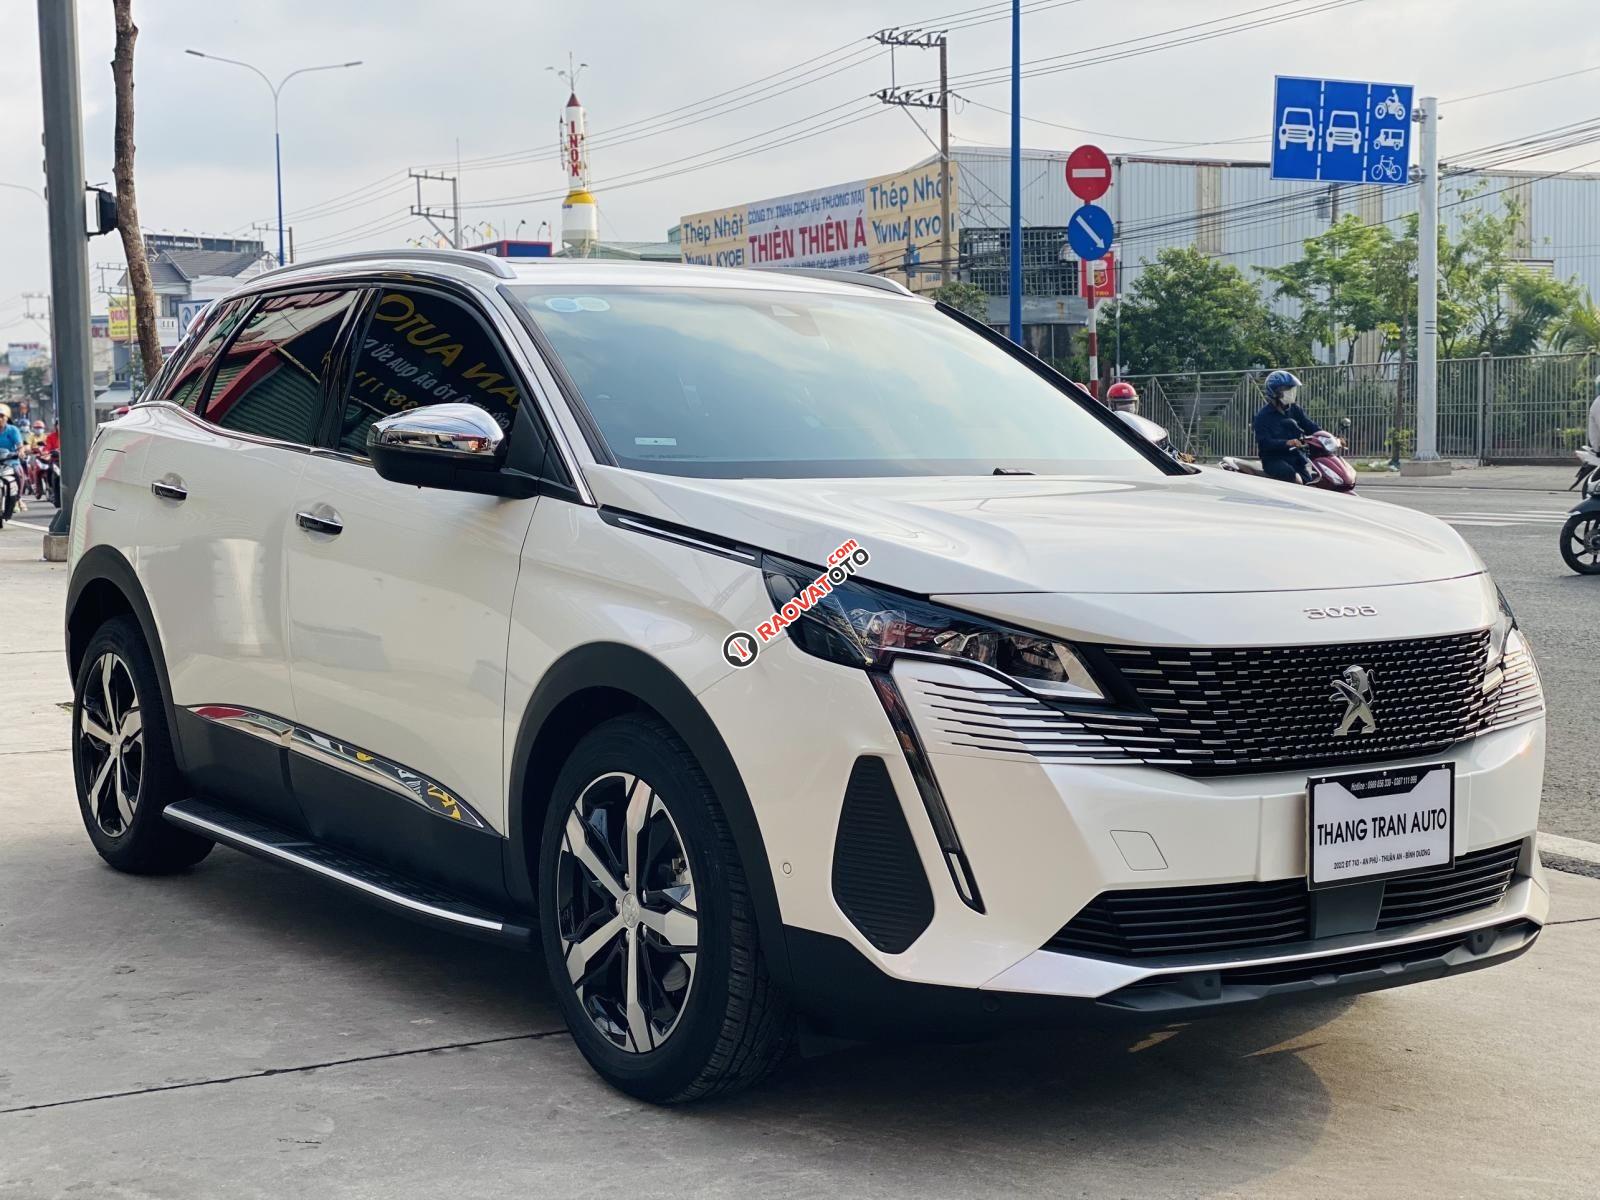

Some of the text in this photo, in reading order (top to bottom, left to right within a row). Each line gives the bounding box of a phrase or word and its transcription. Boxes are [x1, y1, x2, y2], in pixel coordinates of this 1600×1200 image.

[570, 121, 579, 176] INOX
[870, 181, 908, 212] Thép
[684, 213, 744, 247] Thép Nhật
[749, 210, 866, 263] THIÊN THIÊN Á
[914, 212, 954, 238] KYOI
[716, 248, 744, 267] KYOEI
[1303, 604, 1378, 619] 3008
[1317, 808, 1446, 846] THANG TRAN AUTO
